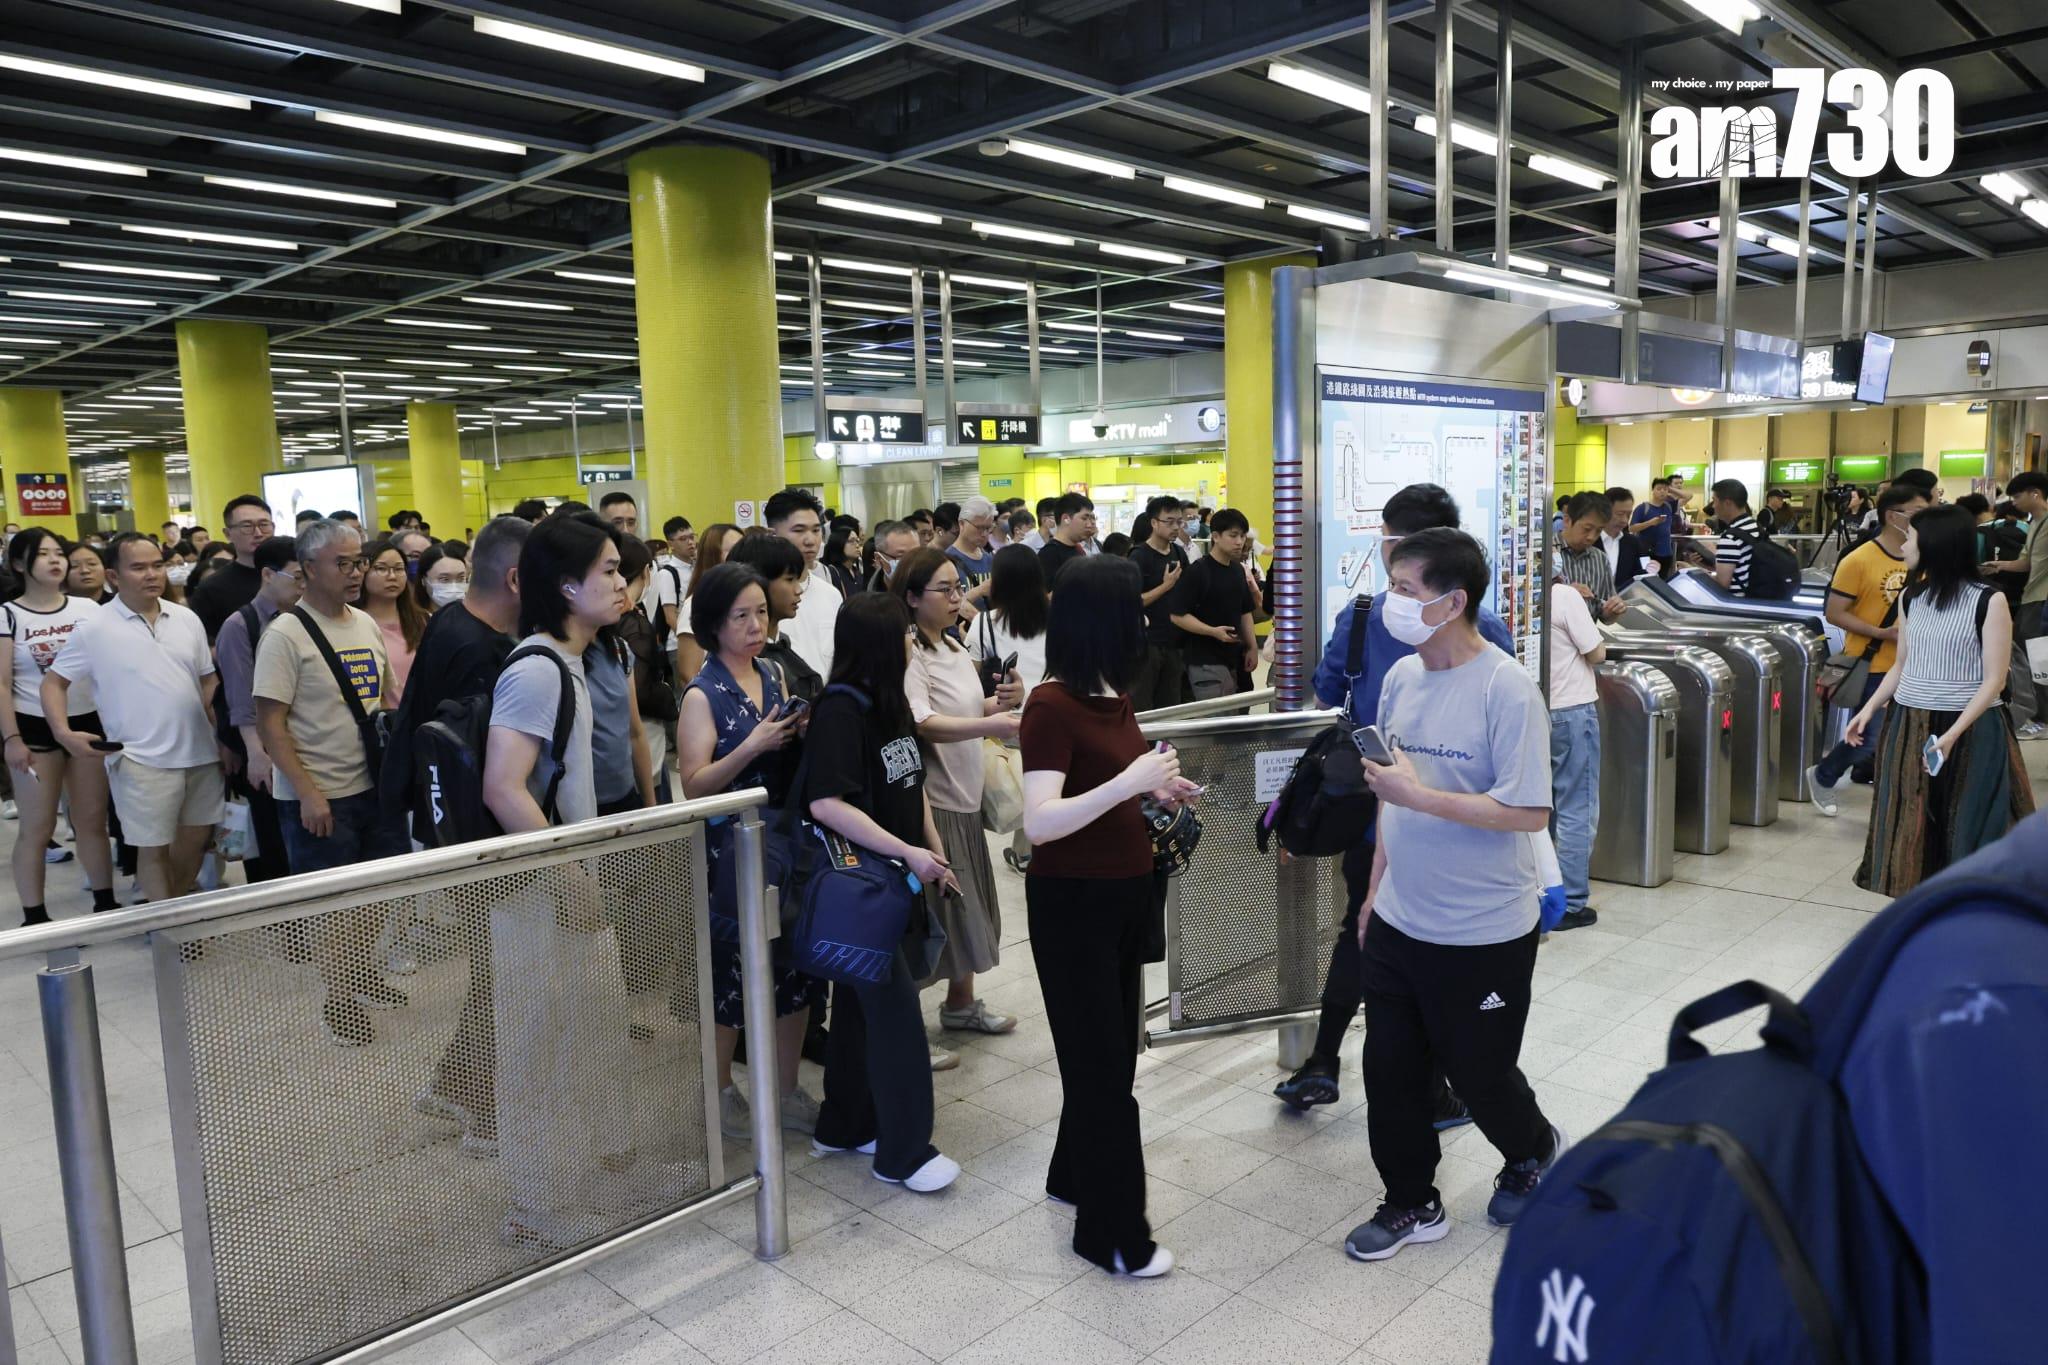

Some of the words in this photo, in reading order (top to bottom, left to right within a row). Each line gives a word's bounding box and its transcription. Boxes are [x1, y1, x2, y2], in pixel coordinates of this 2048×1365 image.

[1001, 420, 1027, 434] 升降機
[886, 447, 915, 457] CLEAN
[915, 445, 944, 456] LIVING
[24, 628, 49, 641] LOS
[428, 765, 444, 825] FILA
[1480, 1001, 1506, 1010] adidas
